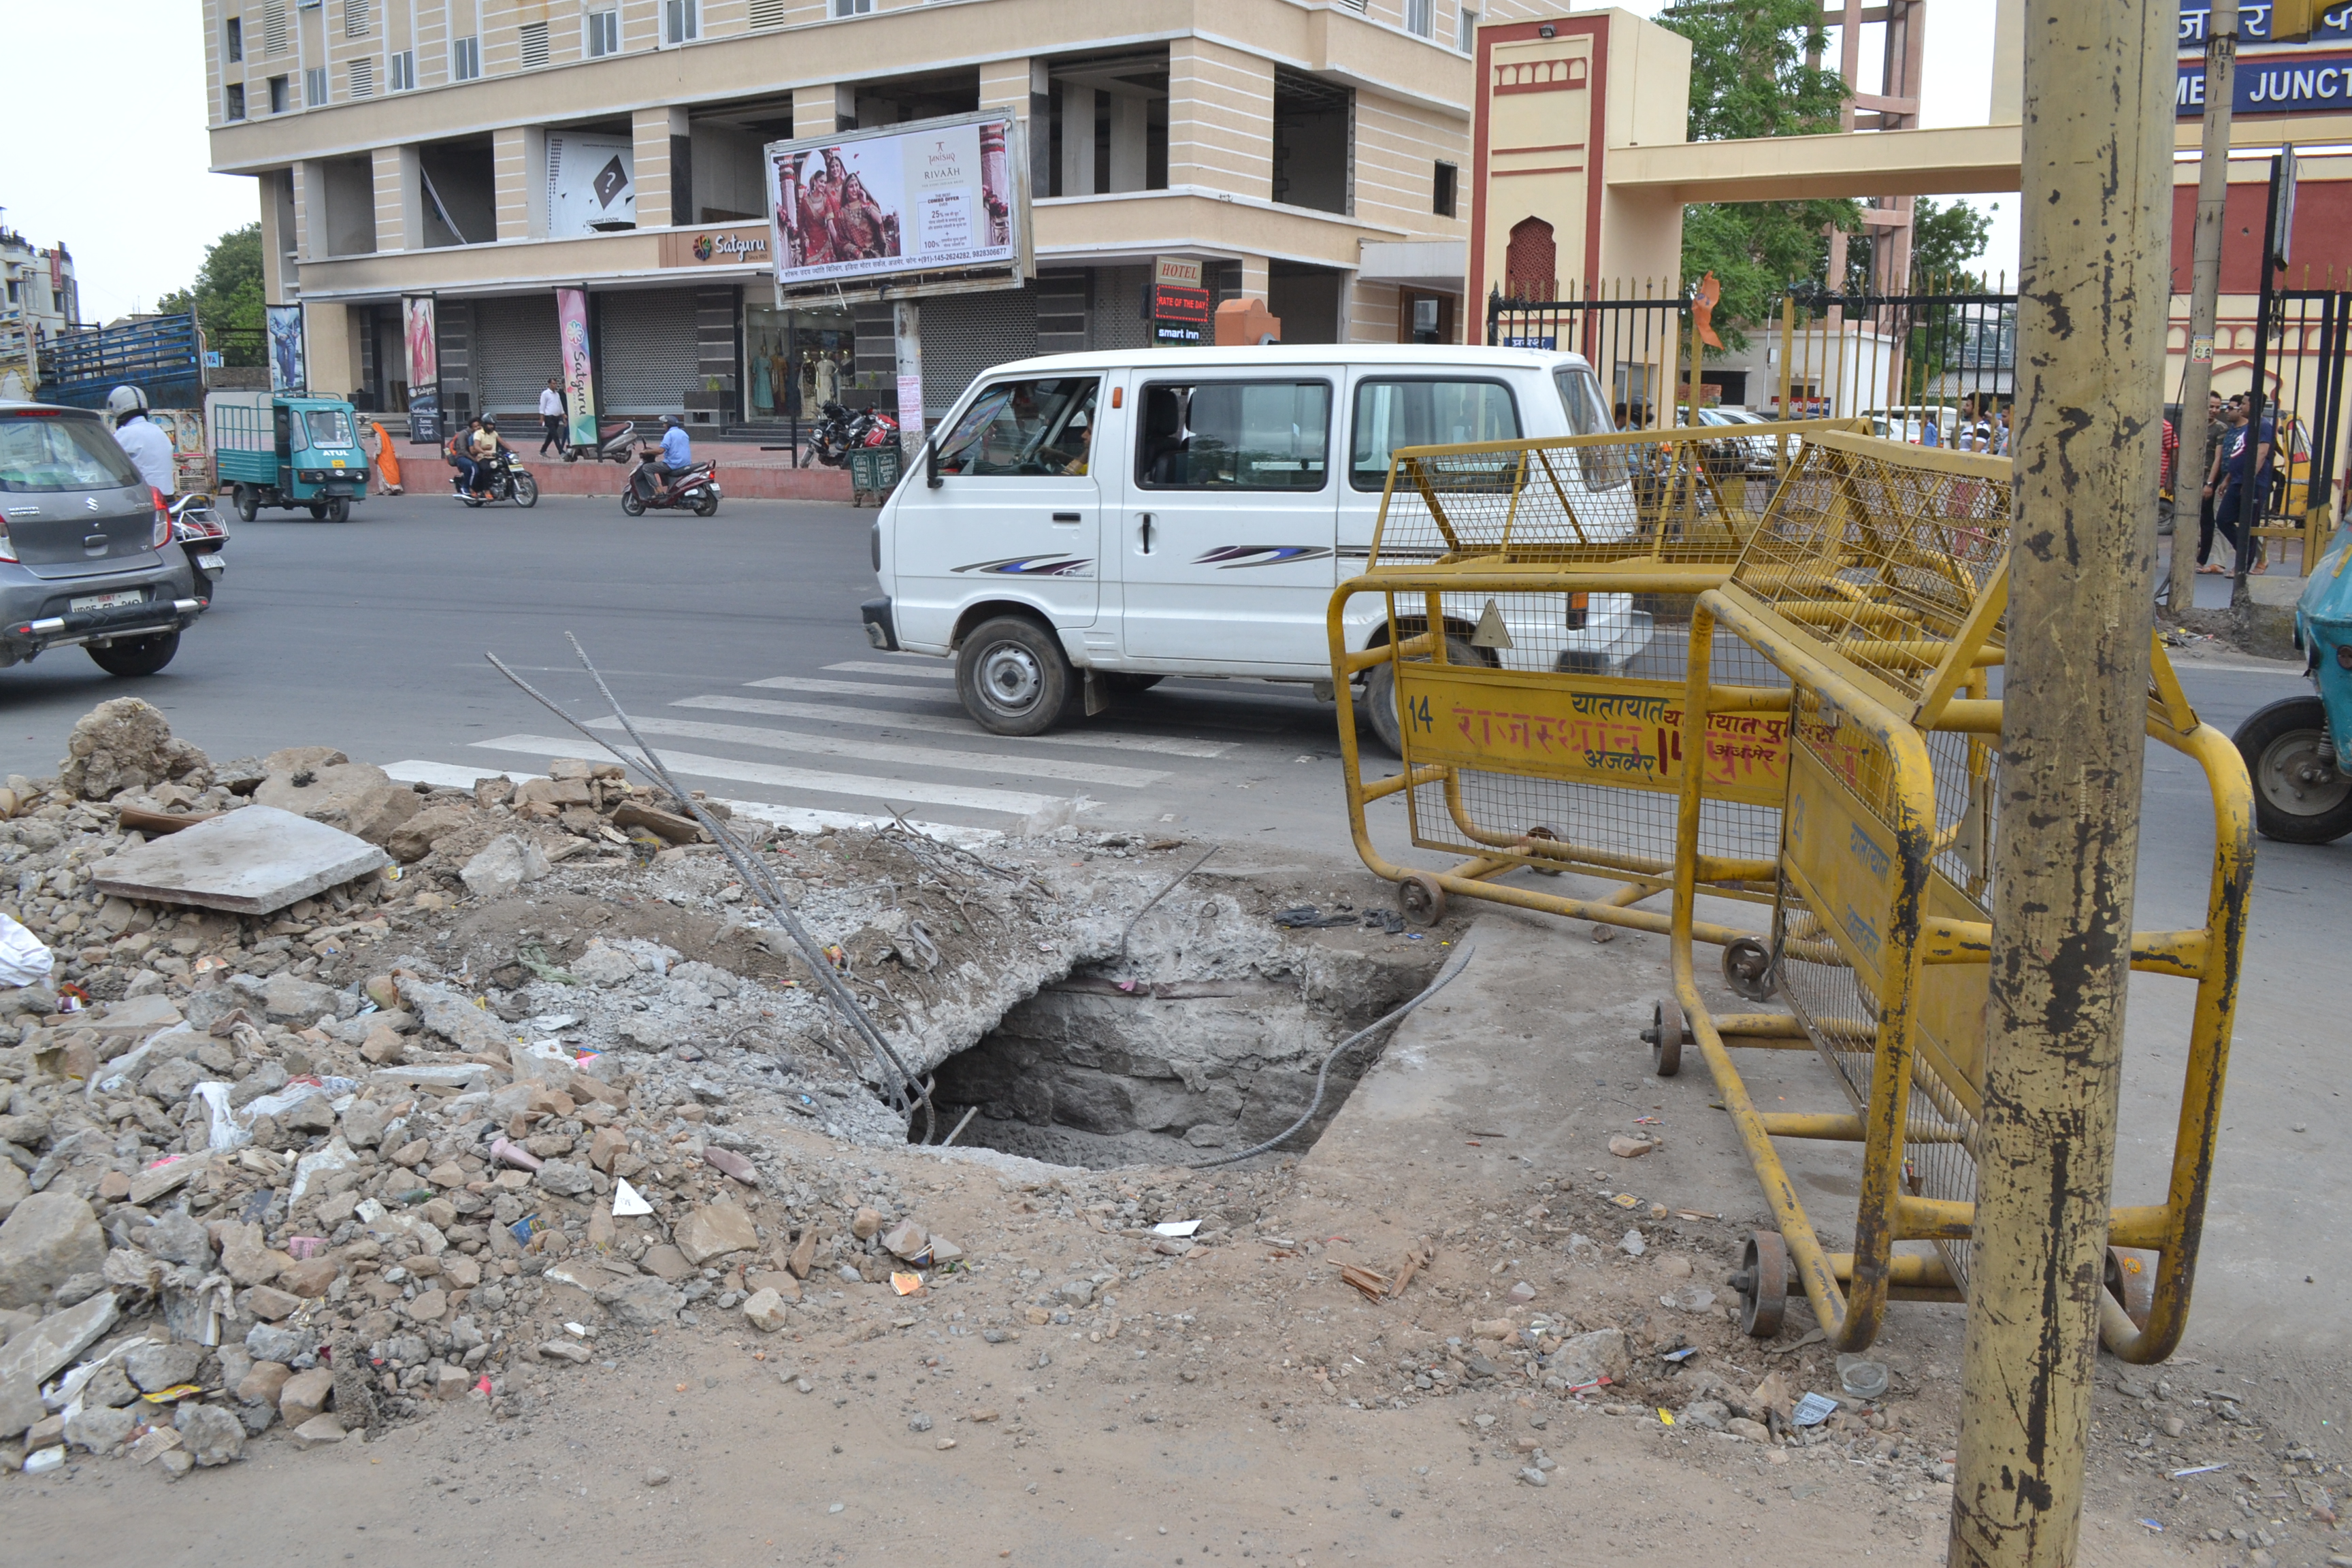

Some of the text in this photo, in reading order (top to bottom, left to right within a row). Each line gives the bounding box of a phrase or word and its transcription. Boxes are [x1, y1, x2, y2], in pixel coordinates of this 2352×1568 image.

[928, 152, 956, 165] TANISHQ
[715, 234, 766, 262] Satguru
[972, 248, 1007, 257] 9828306677
[1162, 263, 1197, 279] HOTEL
[1158, 296, 1206, 310] RATE OF THE DAY
[1158, 329, 1199, 339] smart inn
[570, 350, 587, 416] Satguru
[417, 387, 437, 395] Satguru
[98, 594, 116, 602] ARMY
[1571, 693, 1671, 724] यातायात
[1452, 708, 1643, 764] राजस्थान
[1582, 747, 1657, 782] अजमेर
